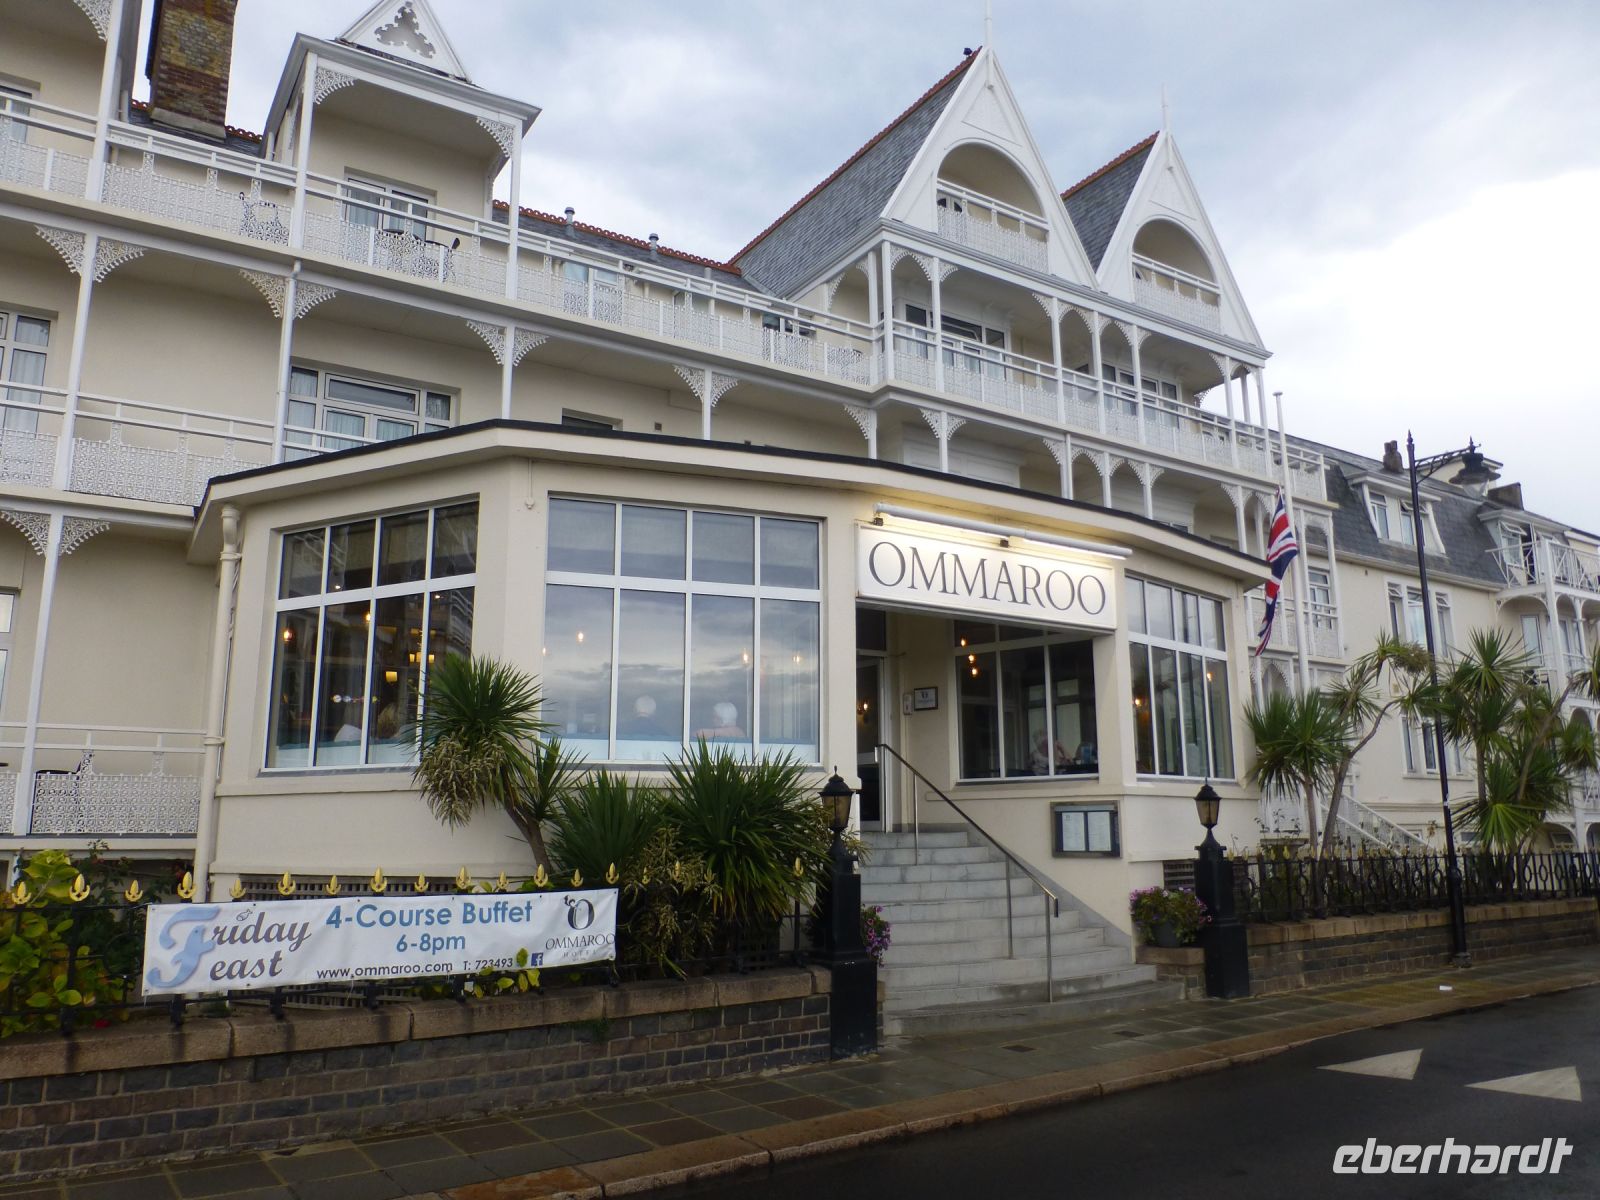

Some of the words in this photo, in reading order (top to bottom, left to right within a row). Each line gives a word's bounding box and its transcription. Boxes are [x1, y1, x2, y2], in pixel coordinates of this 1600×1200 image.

[868, 541, 1106, 615] OMMAROO
[326, 904, 452, 929] 4-Course
[462, 901, 533, 924] Buffet
[396, 933, 466, 955] 6-8pm
[545, 933, 616, 950] OMMAROO
[316, 962, 453, 979] www.ommaroo.com
[463, 960, 472, 971] T:
[475, 957, 514, 970] 723493
